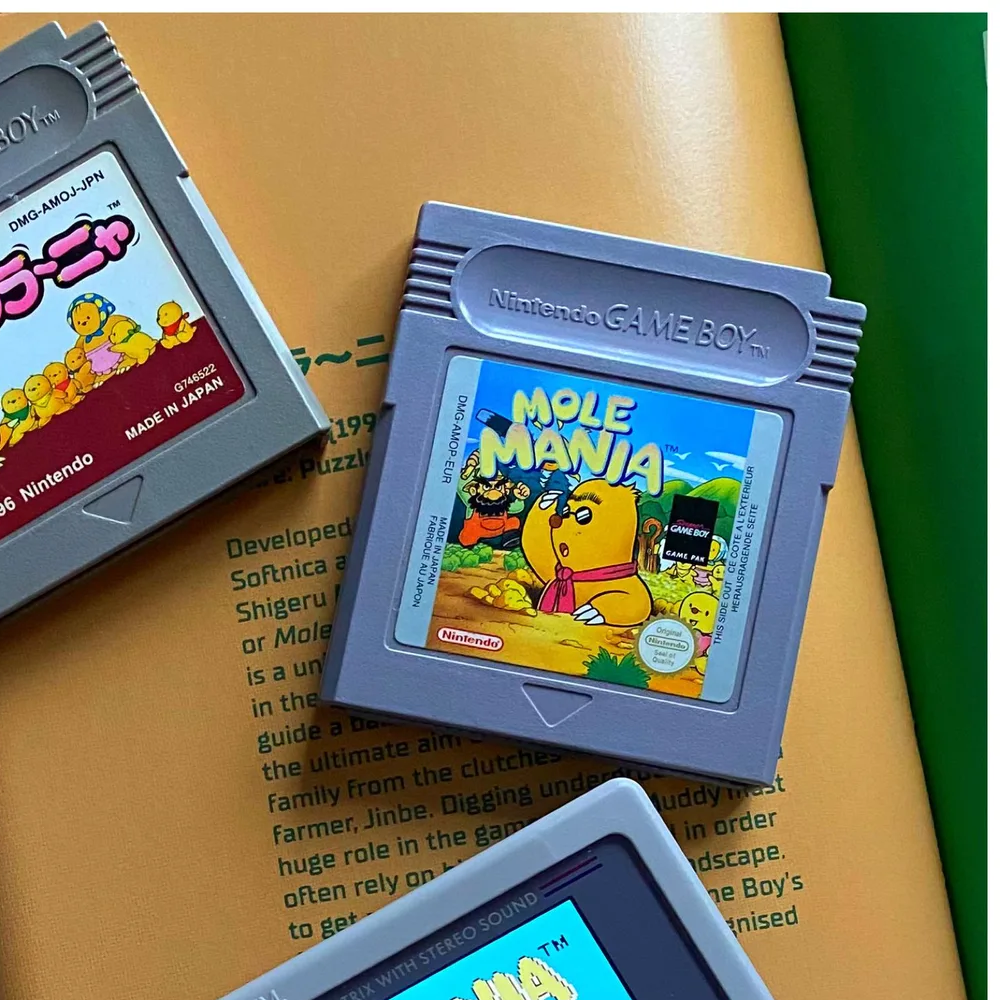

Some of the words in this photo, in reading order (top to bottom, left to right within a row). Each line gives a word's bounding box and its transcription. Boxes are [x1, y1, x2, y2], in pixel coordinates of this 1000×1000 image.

[8, 169, 105, 233] DMG-AMOJ-JPN
[489, 288, 600, 326] Nintendo
[603, 303, 695, 344] GAME
[695, 319, 758, 357] BOY
[174, 363, 218, 393] G746522
[125, 411, 164, 440] MADE
[164, 403, 180, 419] IN
[181, 376, 224, 409] JAPAN
[512, 387, 638, 434] MOLE
[441, 395, 468, 485] DMG-AMOP-EUR
[300, 447, 371, 479] Puzzl
[478, 421, 666, 498] MANIA
[19, 453, 94, 503] Nintendo
[226, 517, 352, 559] Developed
[421, 515, 438, 560] FABRIQUE
[436, 516, 448, 543] MADE
[670, 525, 693, 535] GAME
[693, 529, 710, 538] BOY
[433, 545, 442, 554] IN
[665, 550, 688, 560] GAME
[690, 554, 706, 562] PAK
[731, 530, 752, 613] HERAUSRAGENDE
[748, 504, 759, 530] SEITE
[230, 558, 327, 591] Softnica
[418, 562, 428, 576] AU
[427, 555, 438, 585] JAPAN
[727, 563, 736, 574] CE
[236, 590, 327, 623] Shigeru
[412, 575, 424, 608] JAPON
[723, 581, 733, 602] OUT
[718, 603, 729, 625] SIDE
[242, 636, 265, 654] or
[274, 622, 332, 649] Mole
[441, 630, 499, 649] Nintendo
[648, 637, 687, 650] Nintendo
[656, 627, 682, 637] Original
[713, 625, 724, 645] THIS
[247, 667, 265, 686] is
[272, 665, 286, 681] a
[251, 698, 272, 717] in
[279, 691, 318, 713] the
[257, 720, 321, 754] guide
[330, 720, 343, 736] a
[262, 758, 302, 781] the
[310, 742, 410, 773] ultimate
[267, 785, 340, 814] family
[347, 774, 406, 799] from
[412, 765, 453, 787] the
[461, 749, 562, 778] clutches
[272, 816, 359, 846] farmer,
[364, 803, 434, 830] Jinbe.
[441, 783, 534, 815] Digging
[277, 852, 335, 876] huge
[344, 842, 390, 865] role
[397, 836, 419, 856] in
[425, 831, 466, 850] the
[685, 820, 707, 840] in
[714, 811, 778, 836] order
[284, 882, 347, 909] often
[354, 873, 400, 896] rely
[405, 870, 434, 888] on
[288, 921, 313, 940] to
[320, 911, 358, 940] get
[741, 871, 804, 899] Boy's
[375, 959, 418, 988] WITH
[420, 926, 477, 965] STEREO
[478, 892, 538, 932] SOUND
